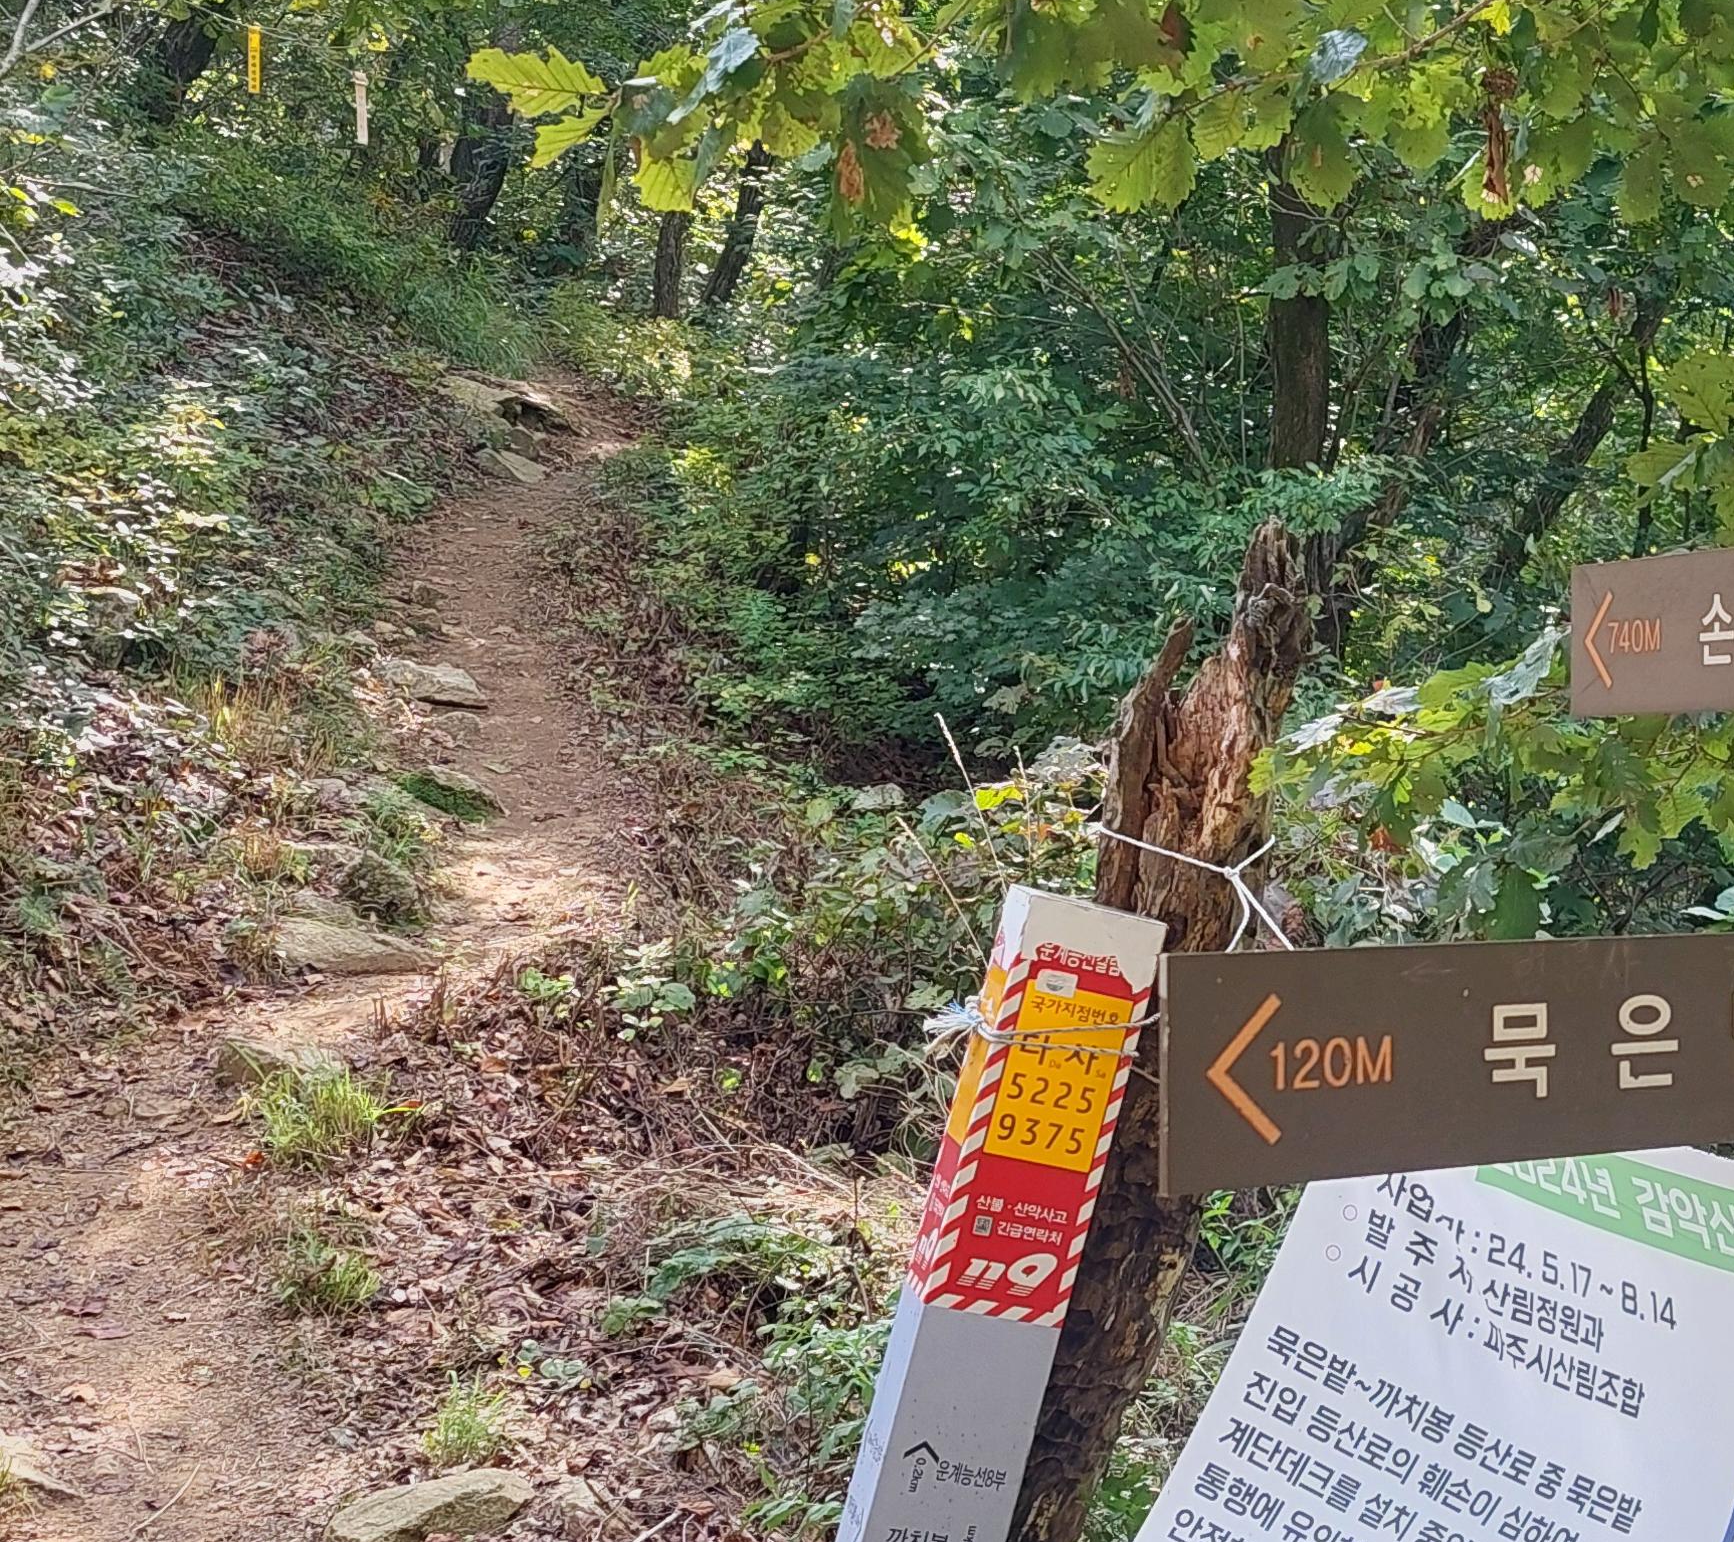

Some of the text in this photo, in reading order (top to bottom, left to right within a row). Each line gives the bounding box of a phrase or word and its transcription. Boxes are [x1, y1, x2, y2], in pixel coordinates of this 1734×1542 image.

[1607, 618, 1662, 654] 740M
[1031, 995, 1119, 1026] 국가지점번호
[1269, 1035, 1393, 1091] 120M
[1006, 1072, 1096, 1114] 5225
[997, 1113, 1086, 1155] 9375
[996, 1221, 1064, 1247] 긴급연락처
[956, 1253, 1058, 1297] 119
[1482, 1279, 1604, 1354] 산림정원과
[1483, 1320, 1646, 1419] 파주시산림조합
[1242, 1370, 1308, 1428] 진입
[1304, 1404, 1421, 1486] 등산로의
[1417, 1465, 1503, 1527] 훼손이
[908, 1457, 927, 1493] 0.2km
[936, 1460, 1007, 1492] 운계능선8부
[1192, 1462, 1286, 1532] 통행에
[1218, 1417, 1363, 1515] 계단데크를
[1357, 1492, 1419, 1542] 설치
[1452, 1423, 1537, 1487] 등산로
[1533, 1460, 1566, 1501] 중
[1566, 1474, 1643, 1536] 묵은밭
